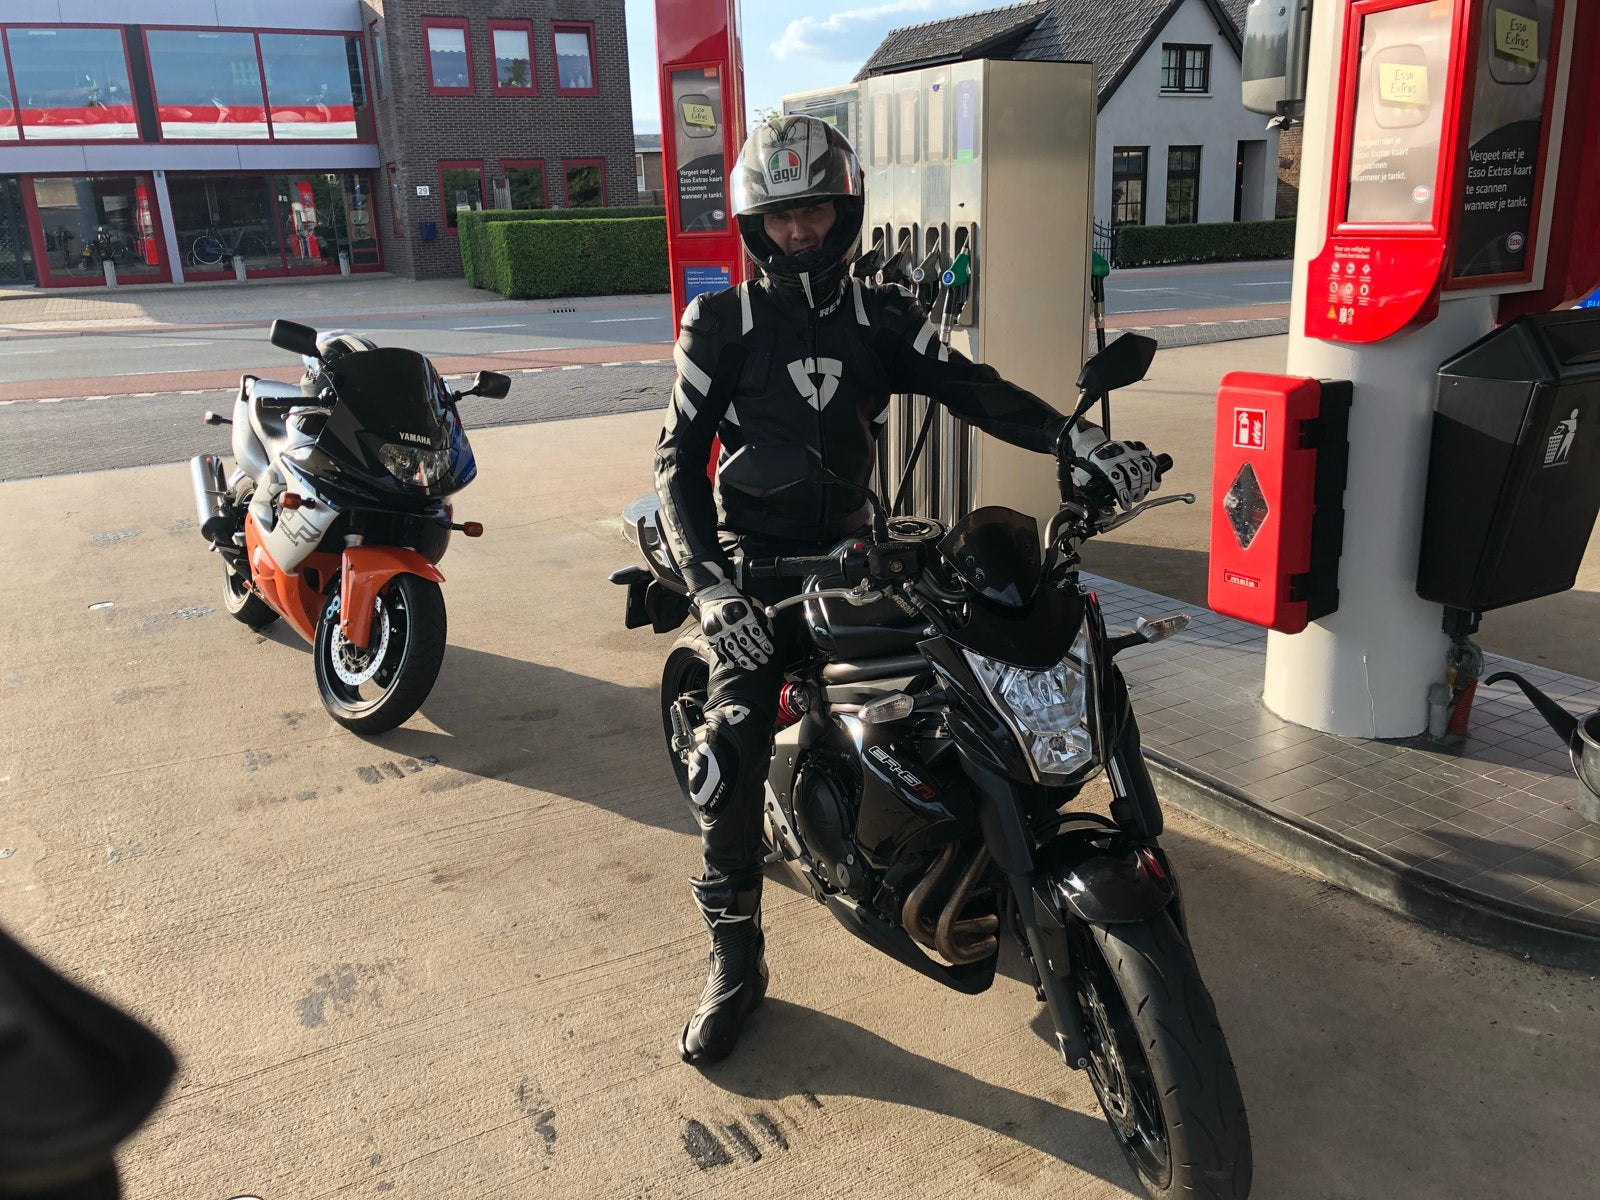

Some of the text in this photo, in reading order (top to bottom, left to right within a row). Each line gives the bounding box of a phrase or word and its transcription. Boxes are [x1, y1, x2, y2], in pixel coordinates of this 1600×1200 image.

[1510, 18, 1527, 32] Esso
[1506, 32, 1528, 48] Extras
[1395, 69, 1414, 80] Esso
[1390, 82, 1416, 94] Extras
[1470, 148, 1525, 164] Vergeet niet je
[774, 167, 798, 182] agv
[1388, 172, 1406, 180] tankt.
[1467, 164, 1532, 178] Esso Extras kaart
[1466, 184, 1508, 194] te scannen
[1464, 196, 1528, 212] wanneer je tankt.
[398, 432, 432, 446] YAMAHA
